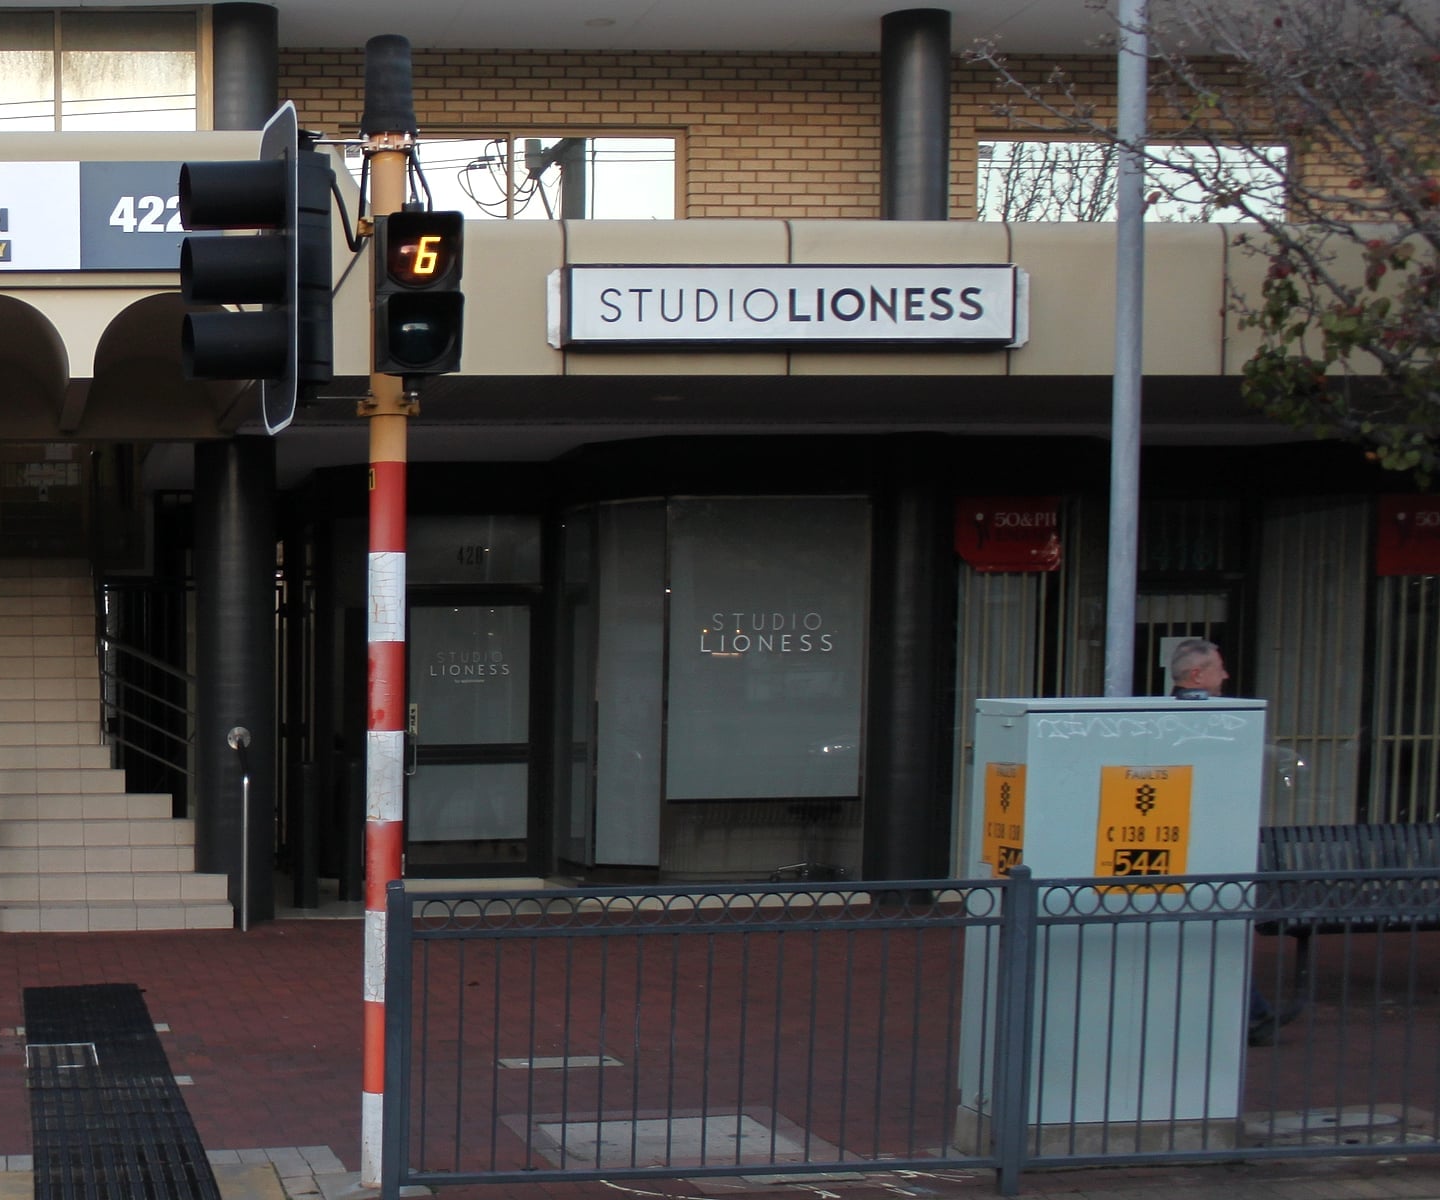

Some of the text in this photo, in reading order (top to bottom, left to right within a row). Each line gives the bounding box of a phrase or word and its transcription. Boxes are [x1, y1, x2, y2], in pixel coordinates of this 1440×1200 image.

[413, 236, 442, 274] 6
[712, 612, 822, 631] STUDIO
[700, 634, 833, 653] LIONESS
[436, 651, 504, 663] STUDIO
[430, 664, 510, 677] LIONESS
[1125, 769, 1169, 780] FAULTS
[1121, 825, 1145, 842] 138
[1155, 825, 1180, 842] 138
[1114, 850, 1169, 876] 544
